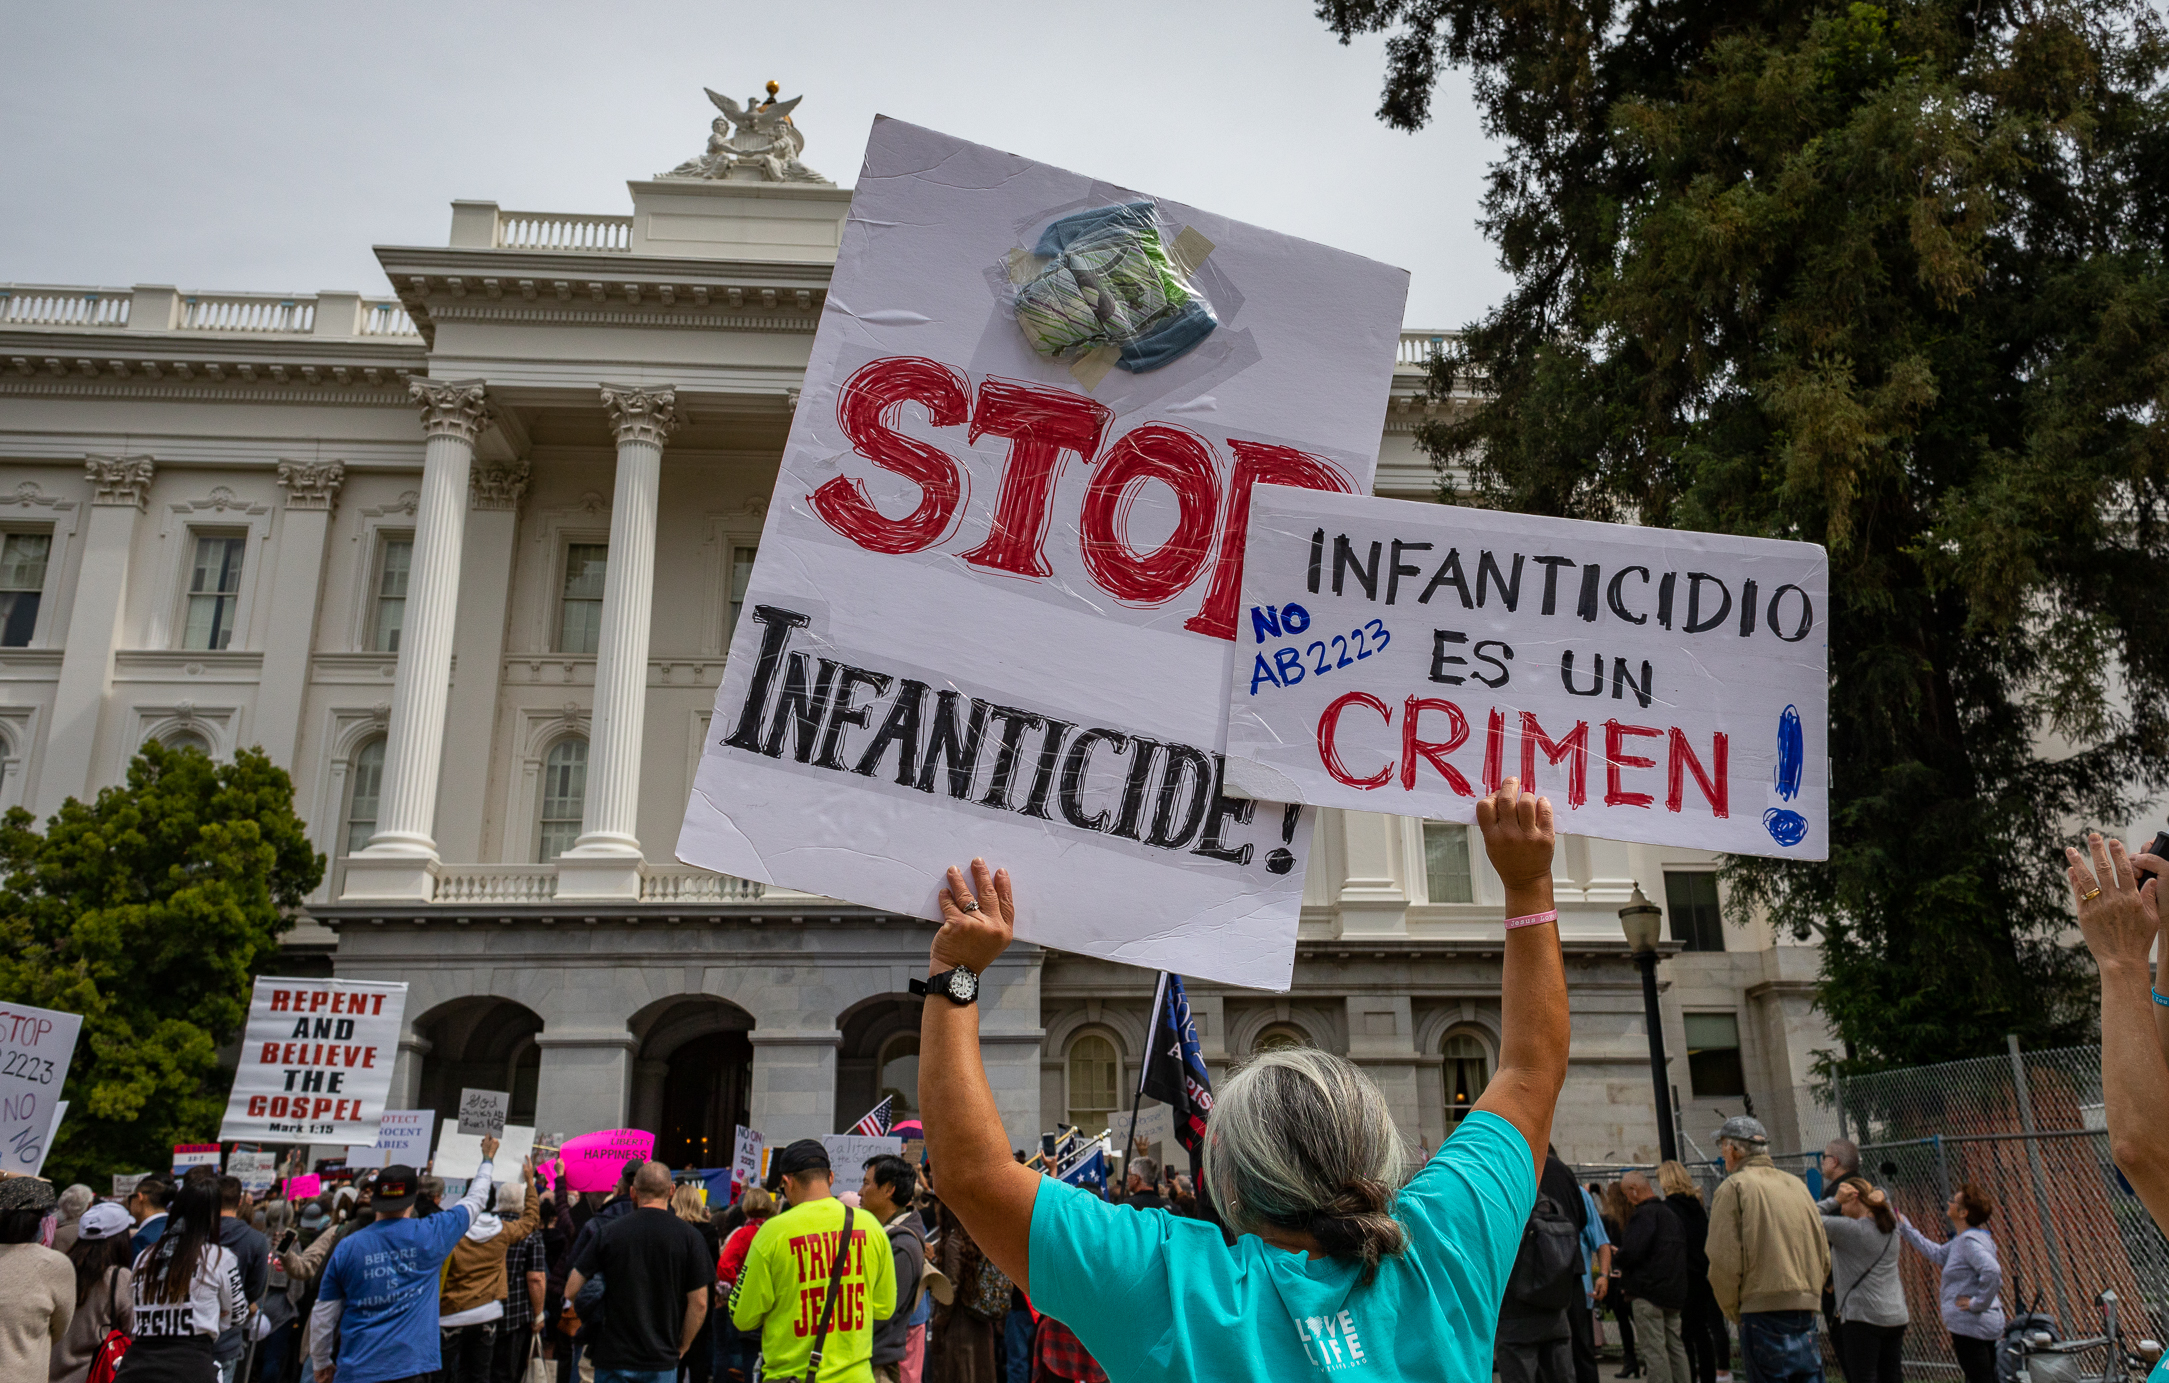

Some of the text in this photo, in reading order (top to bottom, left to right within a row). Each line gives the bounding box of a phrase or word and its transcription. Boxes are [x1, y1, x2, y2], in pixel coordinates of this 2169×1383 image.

[1307, 527, 1813, 642] INFANTICIDIO
[1251, 602, 1310, 644] NO
[1250, 618, 1392, 695] AB2223
[1428, 629, 1652, 708] ES UN
[1317, 690, 1730, 819] CRIMEN
[1511, 918, 1536, 927] Jesus
[270, 990, 387, 1016] REPENT
[292, 1017, 355, 1041] AND
[259, 1042, 377, 1069] BELIEVE
[283, 1069, 345, 1094] THE
[4, 1093, 35, 1122] NO
[247, 1095, 362, 1121] GOSPEL
[381, 1114, 420, 1124] OTECT
[269, 1122, 334, 1135] Mark 1:15
[380, 1127, 423, 1136] OCENT
[737, 1126, 749, 1140] NO
[375, 1139, 409, 1149] ABIES
[610, 1138, 652, 1146] LIBERTY
[583, 1149, 647, 1160] HAPPINESS
[364, 1247, 418, 1266] BEFORE
[386, 1278, 399, 1291] IS
[1303, 1333, 1364, 1366] LIFE
